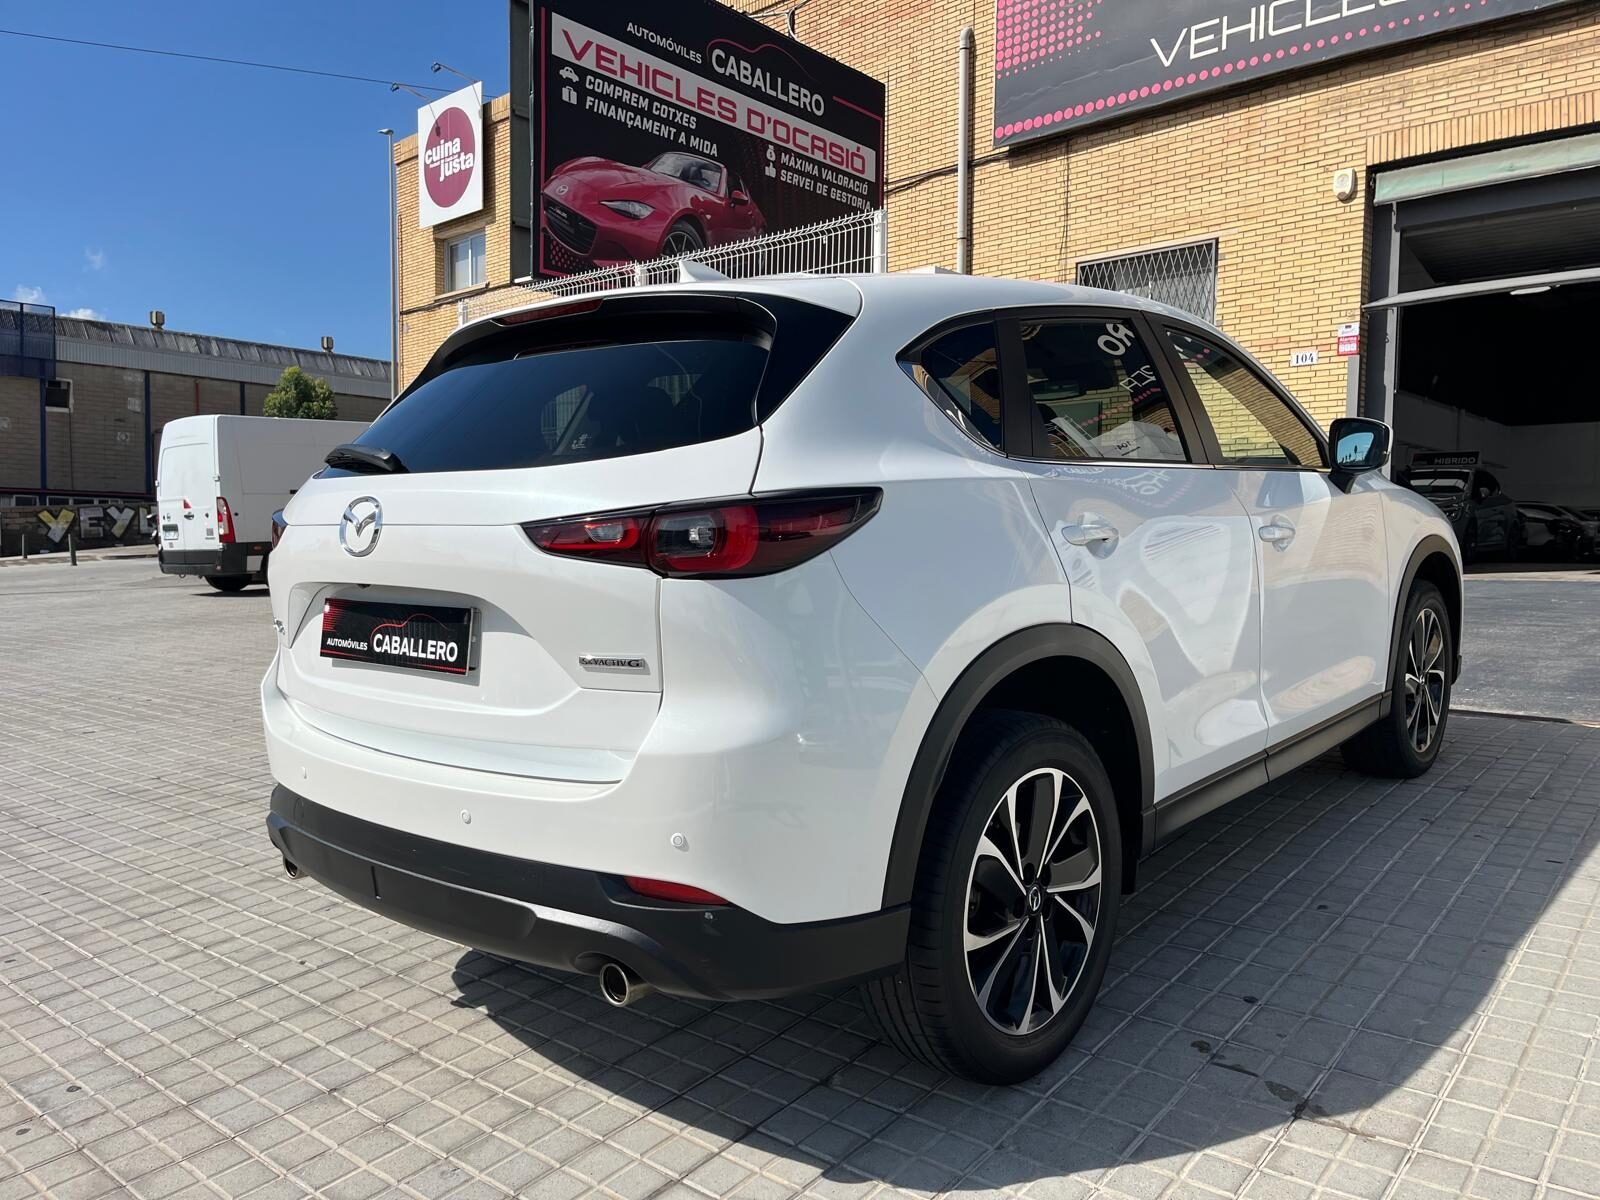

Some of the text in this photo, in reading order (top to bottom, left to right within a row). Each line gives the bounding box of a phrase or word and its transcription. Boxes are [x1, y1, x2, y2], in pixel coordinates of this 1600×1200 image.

[626, 22, 825, 117] AUTOMÓVILES CABALLERO
[561, 29, 867, 176] VEHICLES D'OCASIÓ
[585, 75, 697, 130] COMPREM COTXES
[585, 96, 718, 158] FINANÇAMENT A MIDA
[424, 137, 461, 165] cuina
[439, 151, 474, 182] justa
[780, 152, 869, 195] MÀXIMA VALORACIÓ
[780, 169, 871, 212] SERVEI DE GESTORIA
[1295, 352, 1314, 364] 104
[326, 633, 459, 663] AUTOMÓVILES CABALLERO
